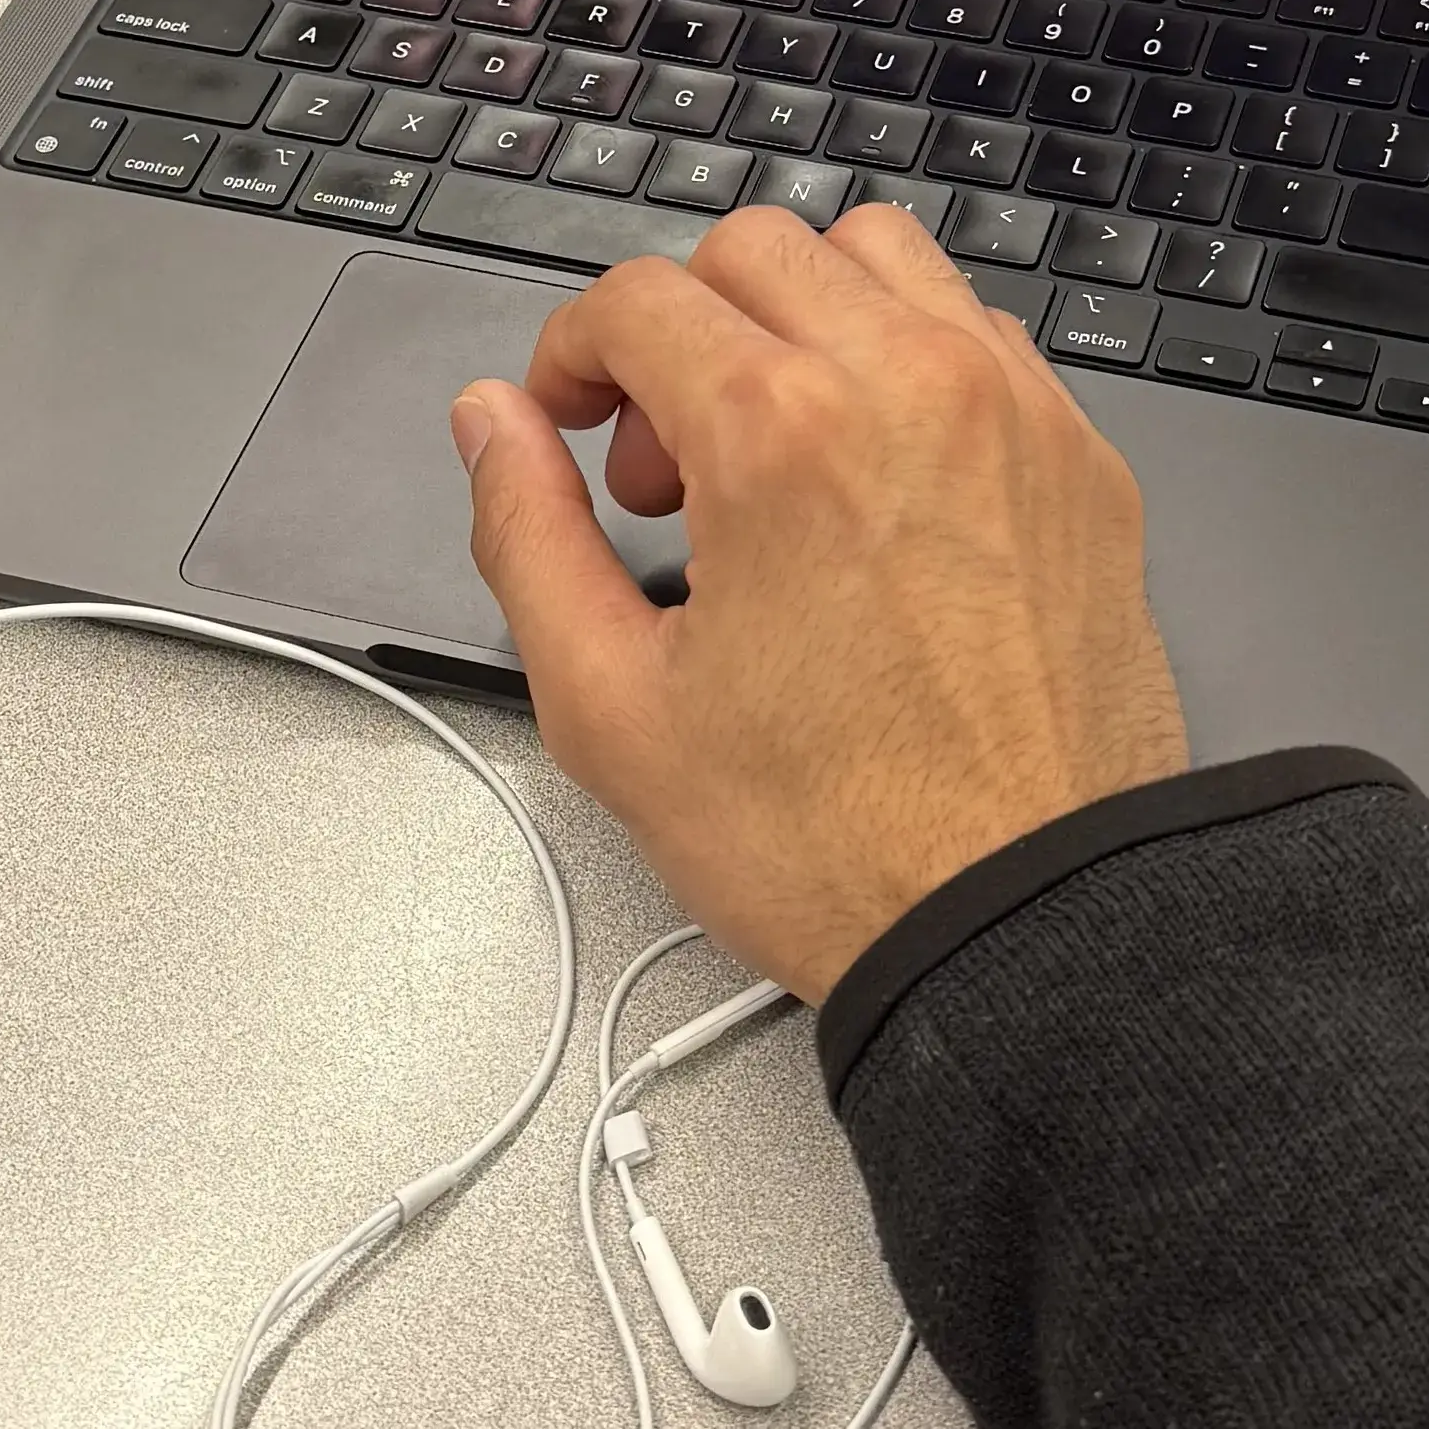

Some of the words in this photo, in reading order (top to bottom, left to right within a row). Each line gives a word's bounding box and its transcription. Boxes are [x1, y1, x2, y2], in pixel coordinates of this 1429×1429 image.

[588, 5, 608, 23] R
[946, 8, 965, 24] 8
[116, 13, 154, 27] caps
[155, 18, 190, 33] lock
[687, 22, 703, 38] T
[298, 27, 316, 43] A
[1044, 24, 1062, 40] 9
[392, 42, 412, 58] S
[782, 37, 799, 54] Y
[1144, 39, 1161, 56] 0
[484, 57, 505, 73] D
[874, 52, 895, 70] U
[74, 76, 114, 91] shift
[580, 74, 600, 90] F
[978, 70, 987, 86] I
[675, 90, 694, 107] G
[1071, 85, 1092, 103] O
[308, 98, 330, 116] Z
[770, 106, 792, 124] H
[1172, 102, 1192, 118] P
[90, 117, 108, 130] fn
[401, 114, 424, 132] X
[498, 131, 518, 148] C
[870, 124, 888, 140] J
[598, 147, 615, 165] V
[970, 140, 990, 159] K
[125, 159, 184, 176] control
[691, 166, 710, 182] B
[1072, 157, 1086, 175] L
[223, 177, 277, 193] option
[790, 180, 812, 201] N
[312, 192, 398, 215] command
[1068, 331, 1127, 350] option
